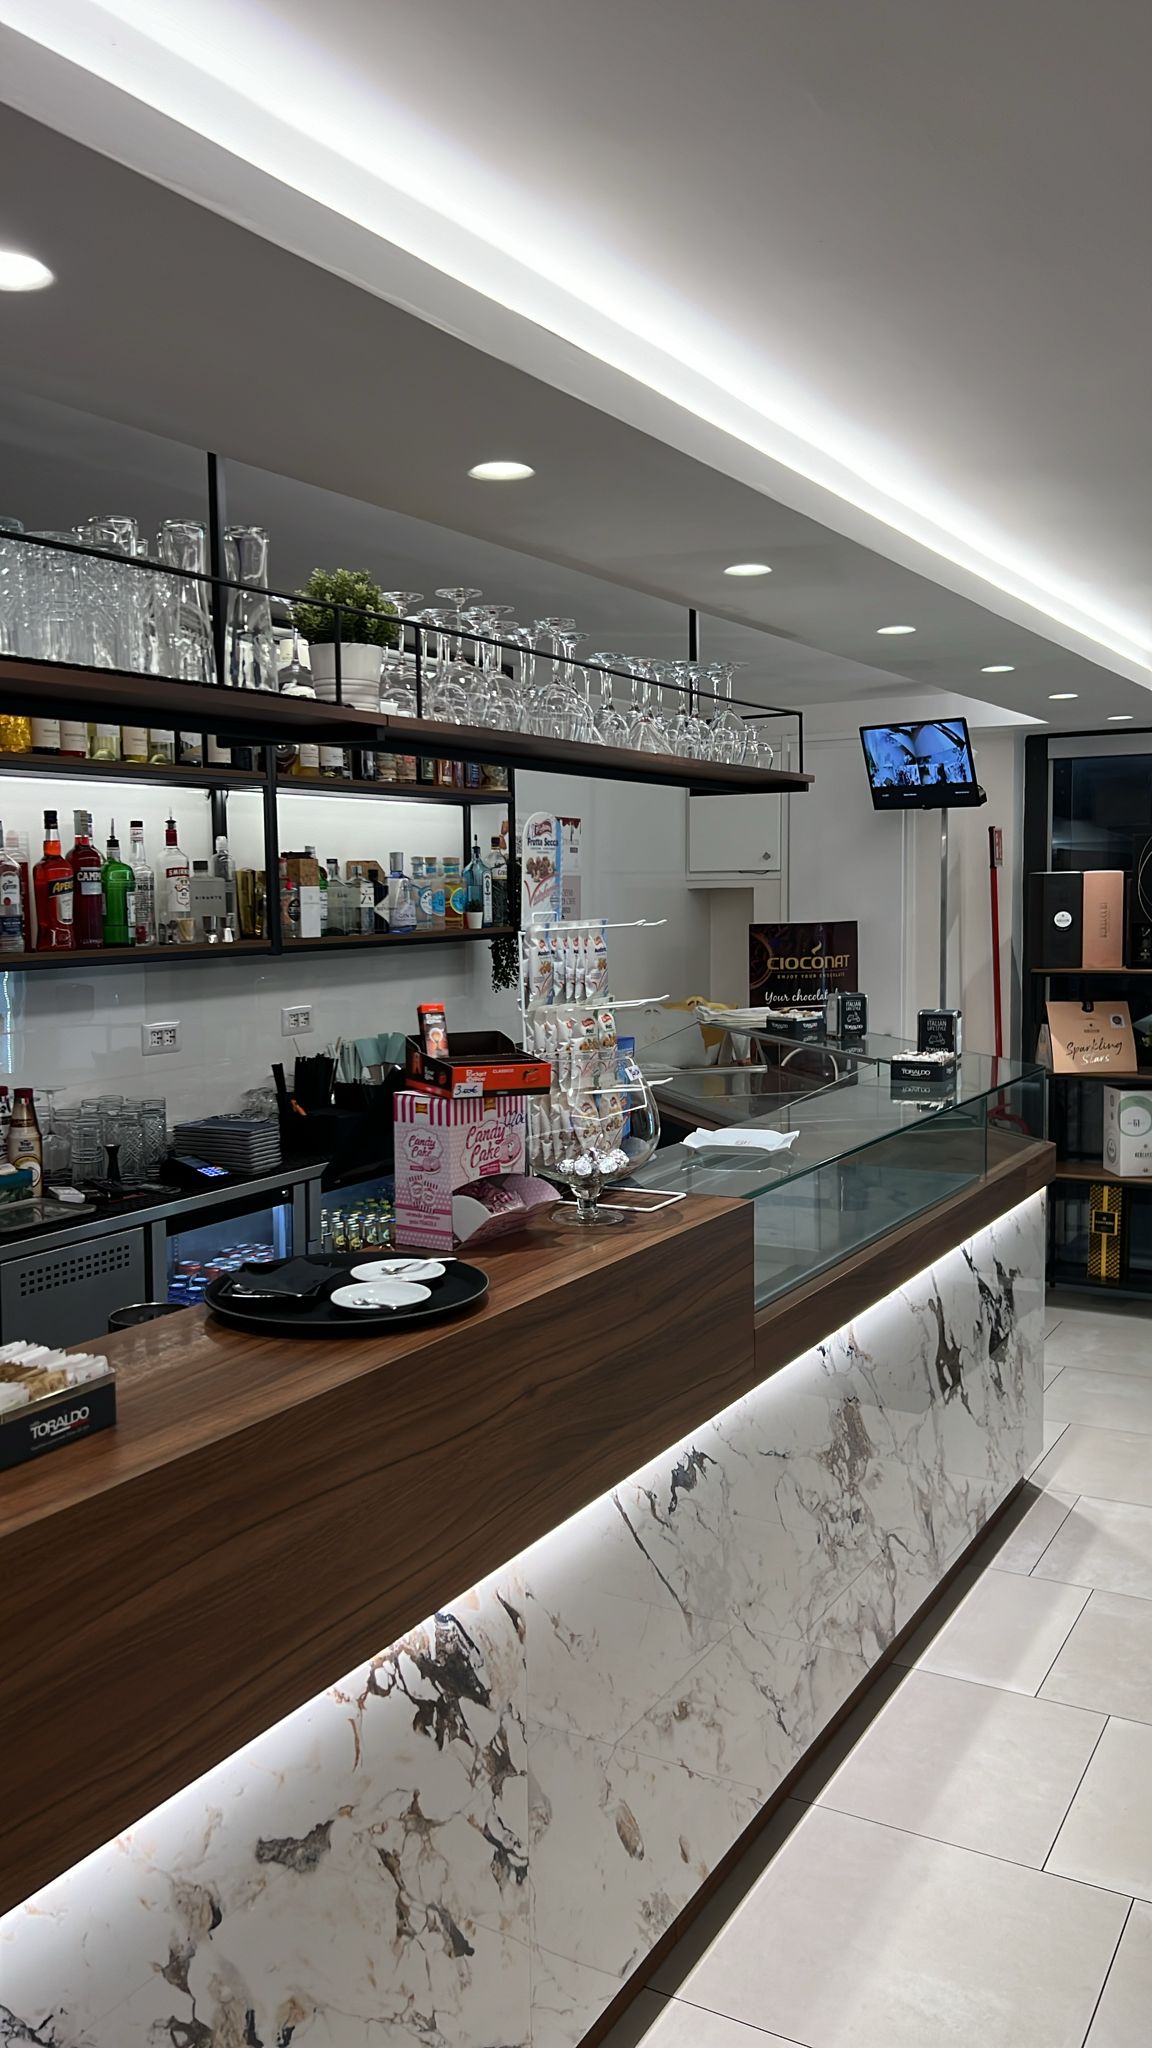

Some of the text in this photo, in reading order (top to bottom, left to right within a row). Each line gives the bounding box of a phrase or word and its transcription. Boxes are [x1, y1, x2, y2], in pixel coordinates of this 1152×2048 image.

[527, 837, 559, 847] Frutta Secca
[767, 954, 851, 970] CIOCONAT
[764, 990, 792, 1005] Your
[926, 1020, 947, 1028] ITALIAN
[1066, 1037, 1123, 1060] Sparkling
[1082, 1054, 1110, 1065] Stars
[901, 1068, 931, 1076] TORALDO
[466, 1119, 506, 1150] Candy
[408, 1135, 437, 1150] Candy
[411, 1146, 433, 1158] Cake
[470, 1141, 501, 1169] Cake
[30, 1406, 90, 1439] TORALDO
